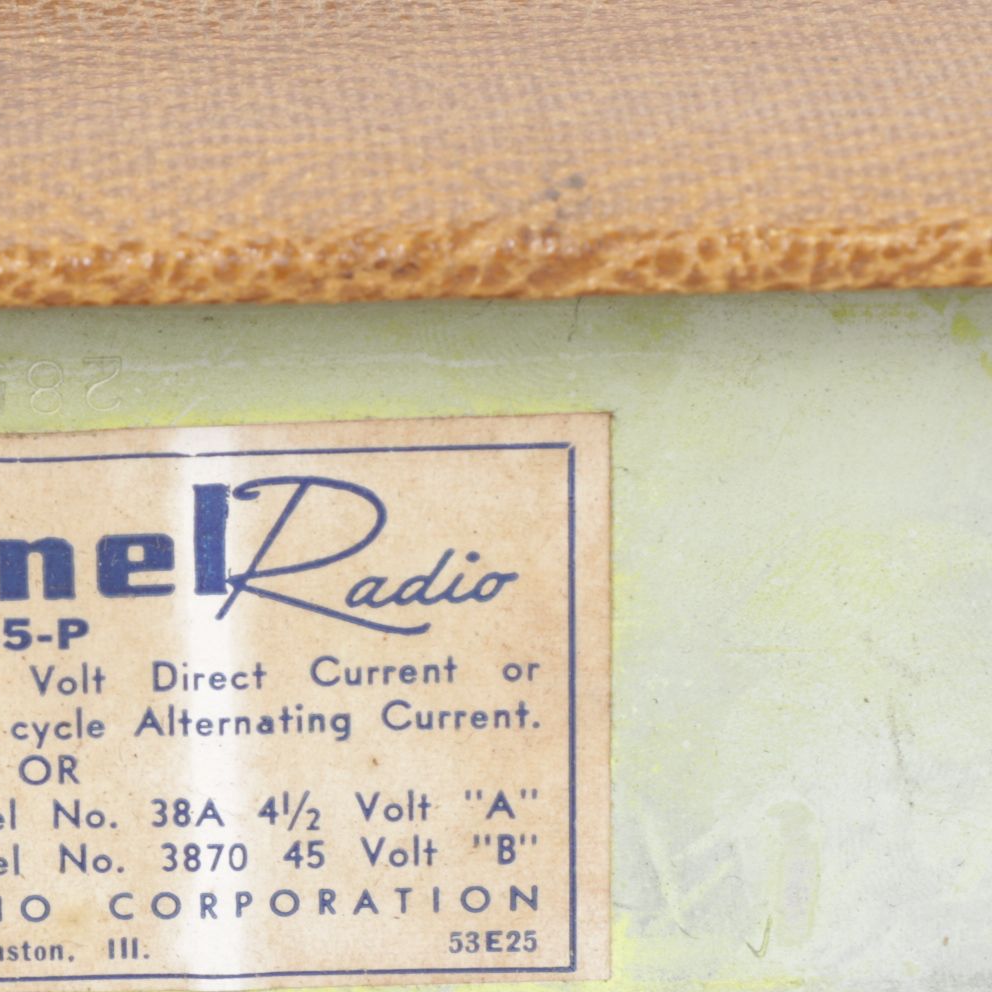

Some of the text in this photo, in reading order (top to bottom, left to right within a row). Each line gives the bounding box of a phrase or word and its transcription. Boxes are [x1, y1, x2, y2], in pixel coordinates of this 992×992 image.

[214, 473, 521, 638] Radio
[28, 661, 107, 697] Volt
[151, 659, 268, 693] Direct
[309, 654, 458, 688] Current
[501, 662, 541, 683] or
[10, 707, 106, 749] cycle
[133, 703, 352, 743] Alternating
[380, 698, 541, 732] Current.
[17, 754, 81, 787] OR
[52, 798, 118, 830] No.
[150, 797, 226, 829] 38A
[354, 788, 432, 823] Volt
[58, 842, 125, 875] No.
[160, 841, 248, 873] 3870
[282, 839, 326, 870] 45
[359, 834, 439, 868] Volt
[108, 884, 539, 921] CORPORATION
[107, 936, 150, 960] Ill.
[448, 929, 538, 954] 53E25
